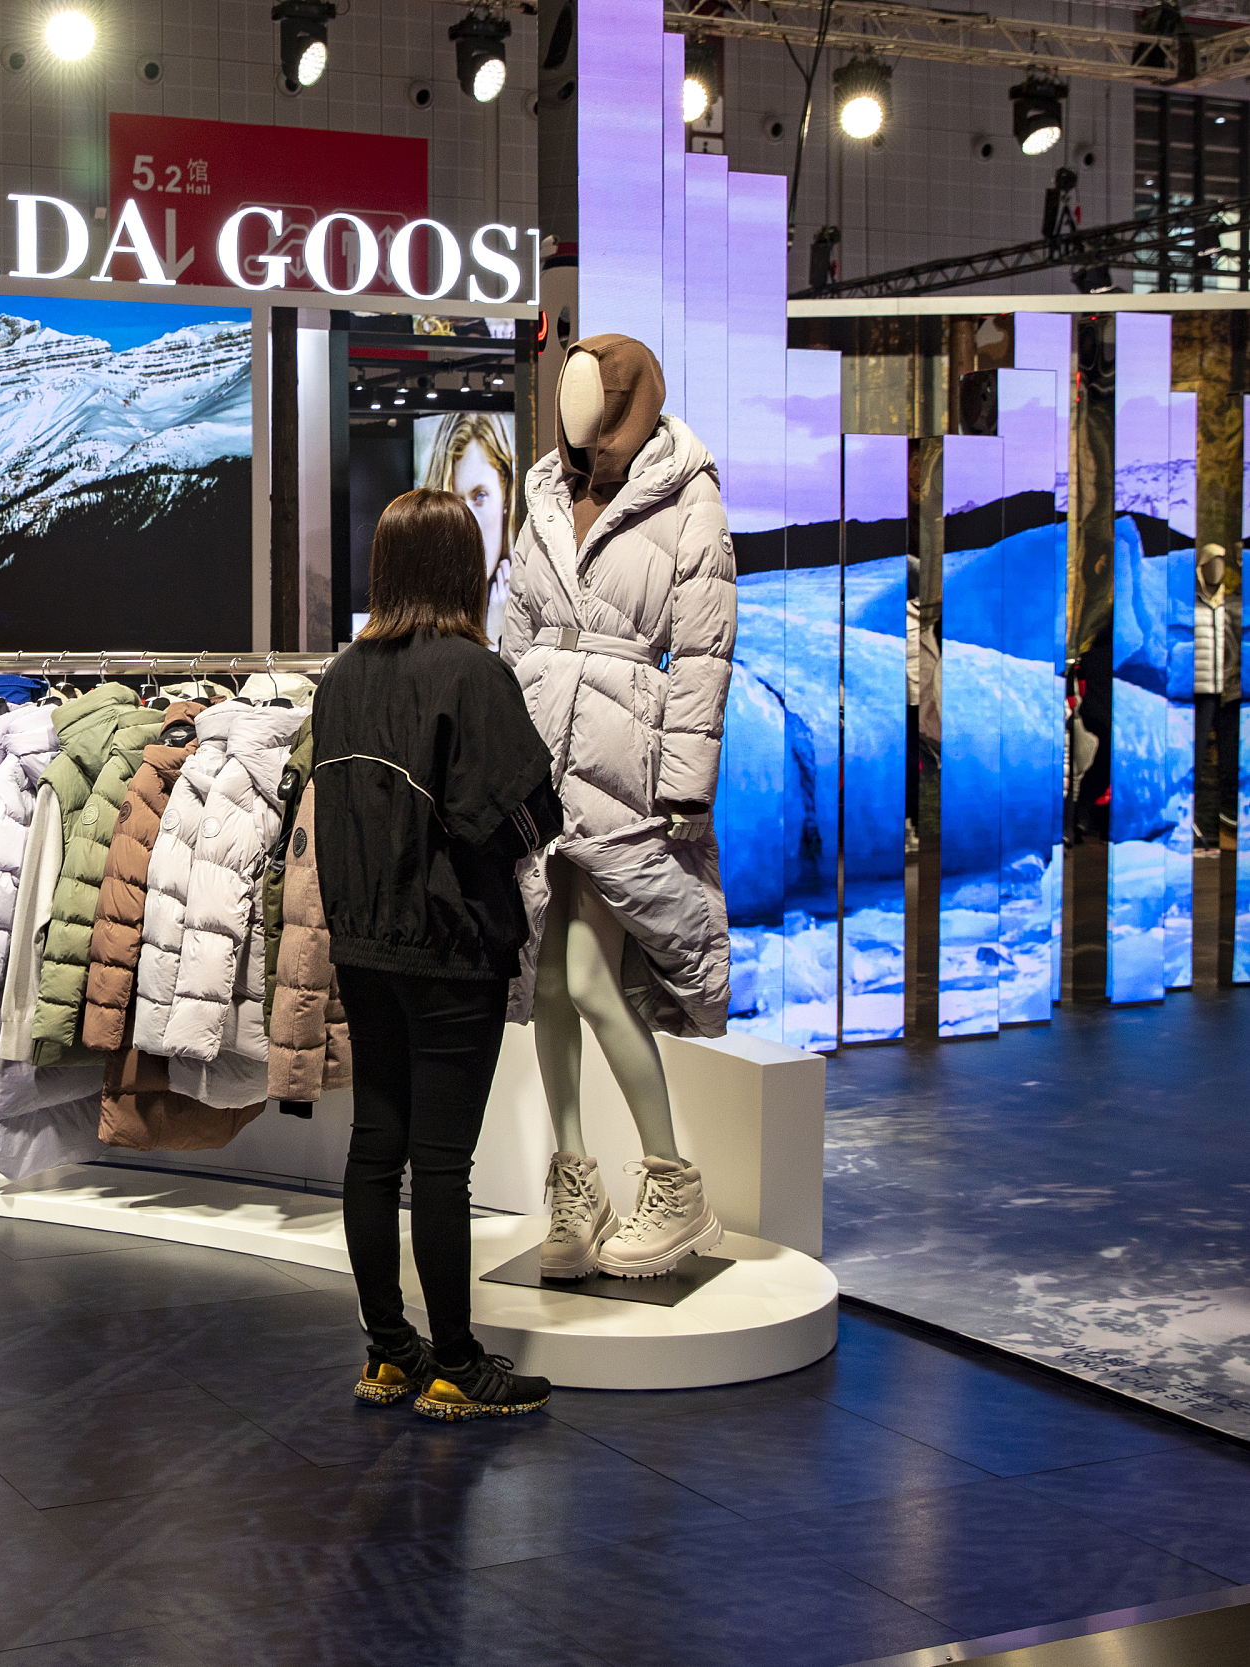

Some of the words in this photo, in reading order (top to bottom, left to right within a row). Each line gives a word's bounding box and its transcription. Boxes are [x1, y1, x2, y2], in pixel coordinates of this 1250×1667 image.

[132, 154, 182, 193] 5.2
[187, 158, 208, 182] 馆
[186, 183, 210, 195] Hall
[1056, 1354, 1109, 1372] MIND
[1110, 1372, 1167, 1394] YOUR
[1164, 1394, 1224, 1413] STEP
